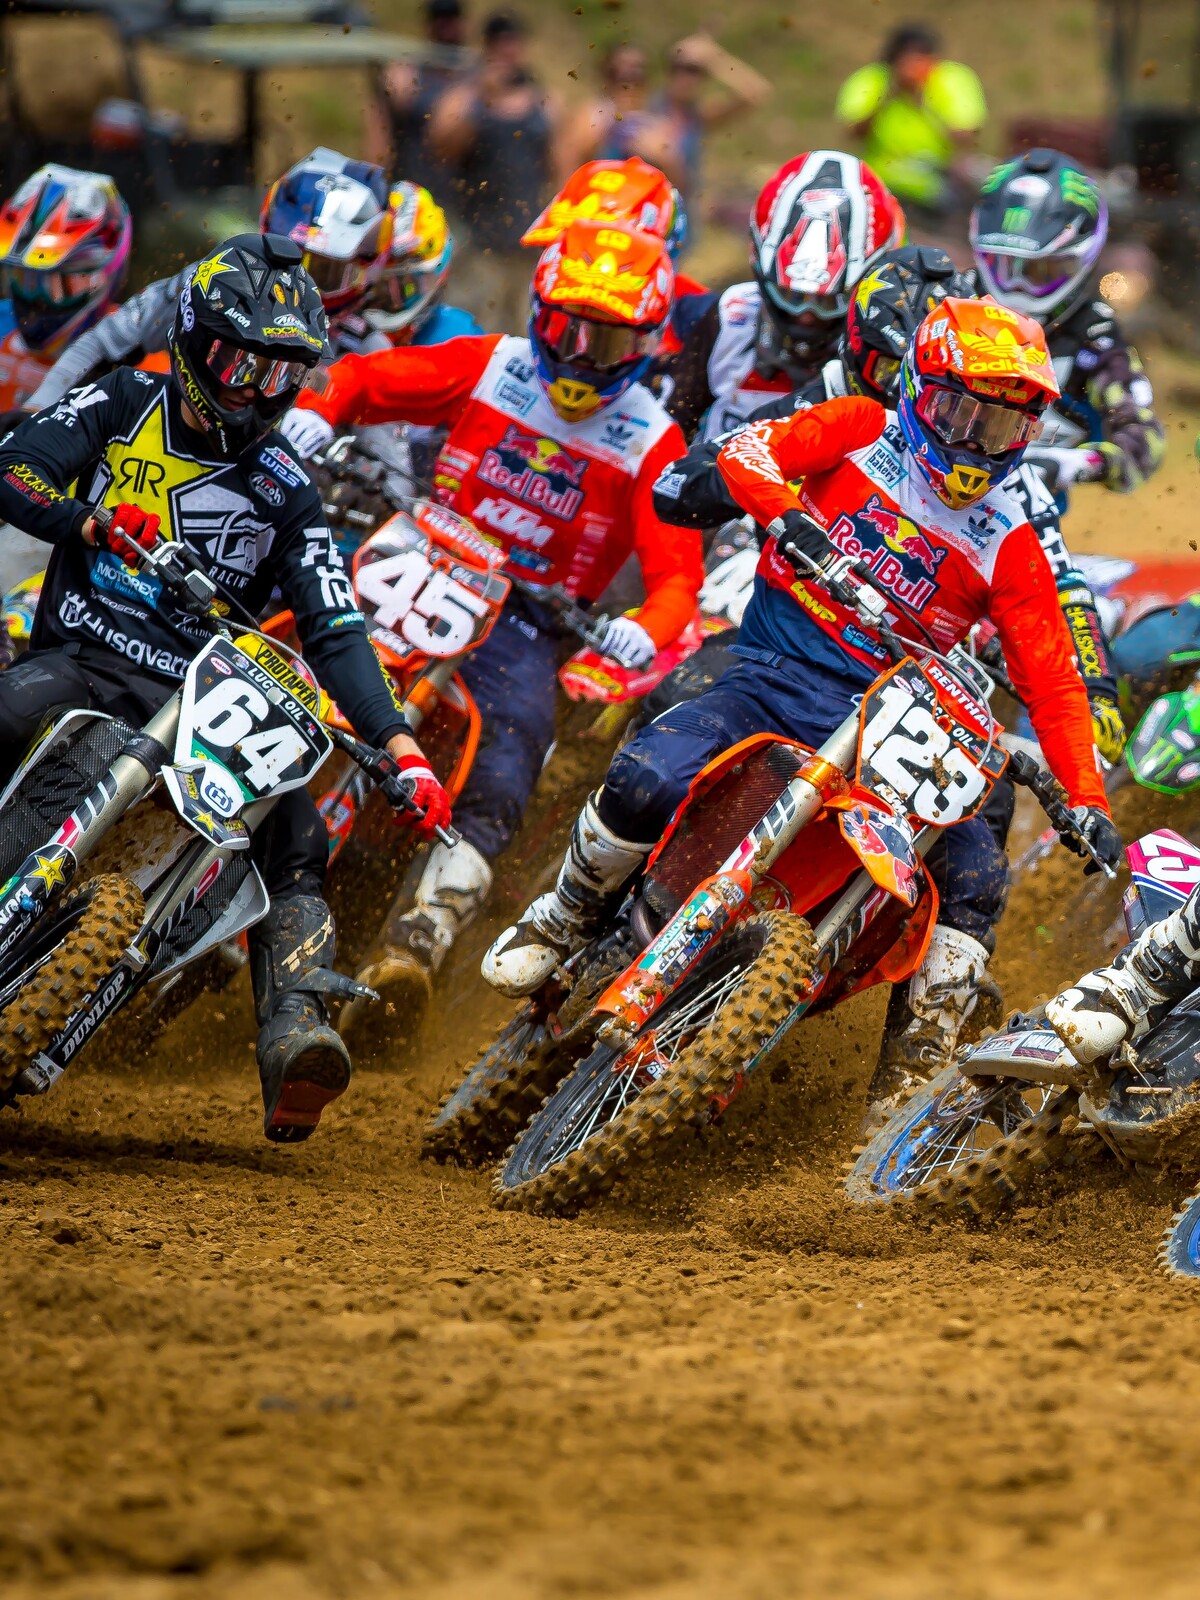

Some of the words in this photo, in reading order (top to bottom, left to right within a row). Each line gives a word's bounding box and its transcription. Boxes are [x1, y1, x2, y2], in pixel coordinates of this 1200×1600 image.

[259, 453, 299, 487] WPS
[478, 452, 530, 496] Red
[529, 473, 582, 519] Bull
[868, 456, 896, 484] bakery
[472, 498, 555, 547] KTM
[98, 562, 157, 599] MOTOREX
[208, 565, 250, 590] RACIN
[829, 515, 888, 576] Red
[875, 554, 936, 611] Bull
[356, 551, 491, 655] 45
[248, 667, 287, 704] LUCS
[285, 700, 303, 721] OIL
[193, 677, 310, 792] 64
[860, 685, 987, 825] 123
[952, 724, 971, 748] OIL
[62, 971, 125, 1061] DUNLOP
